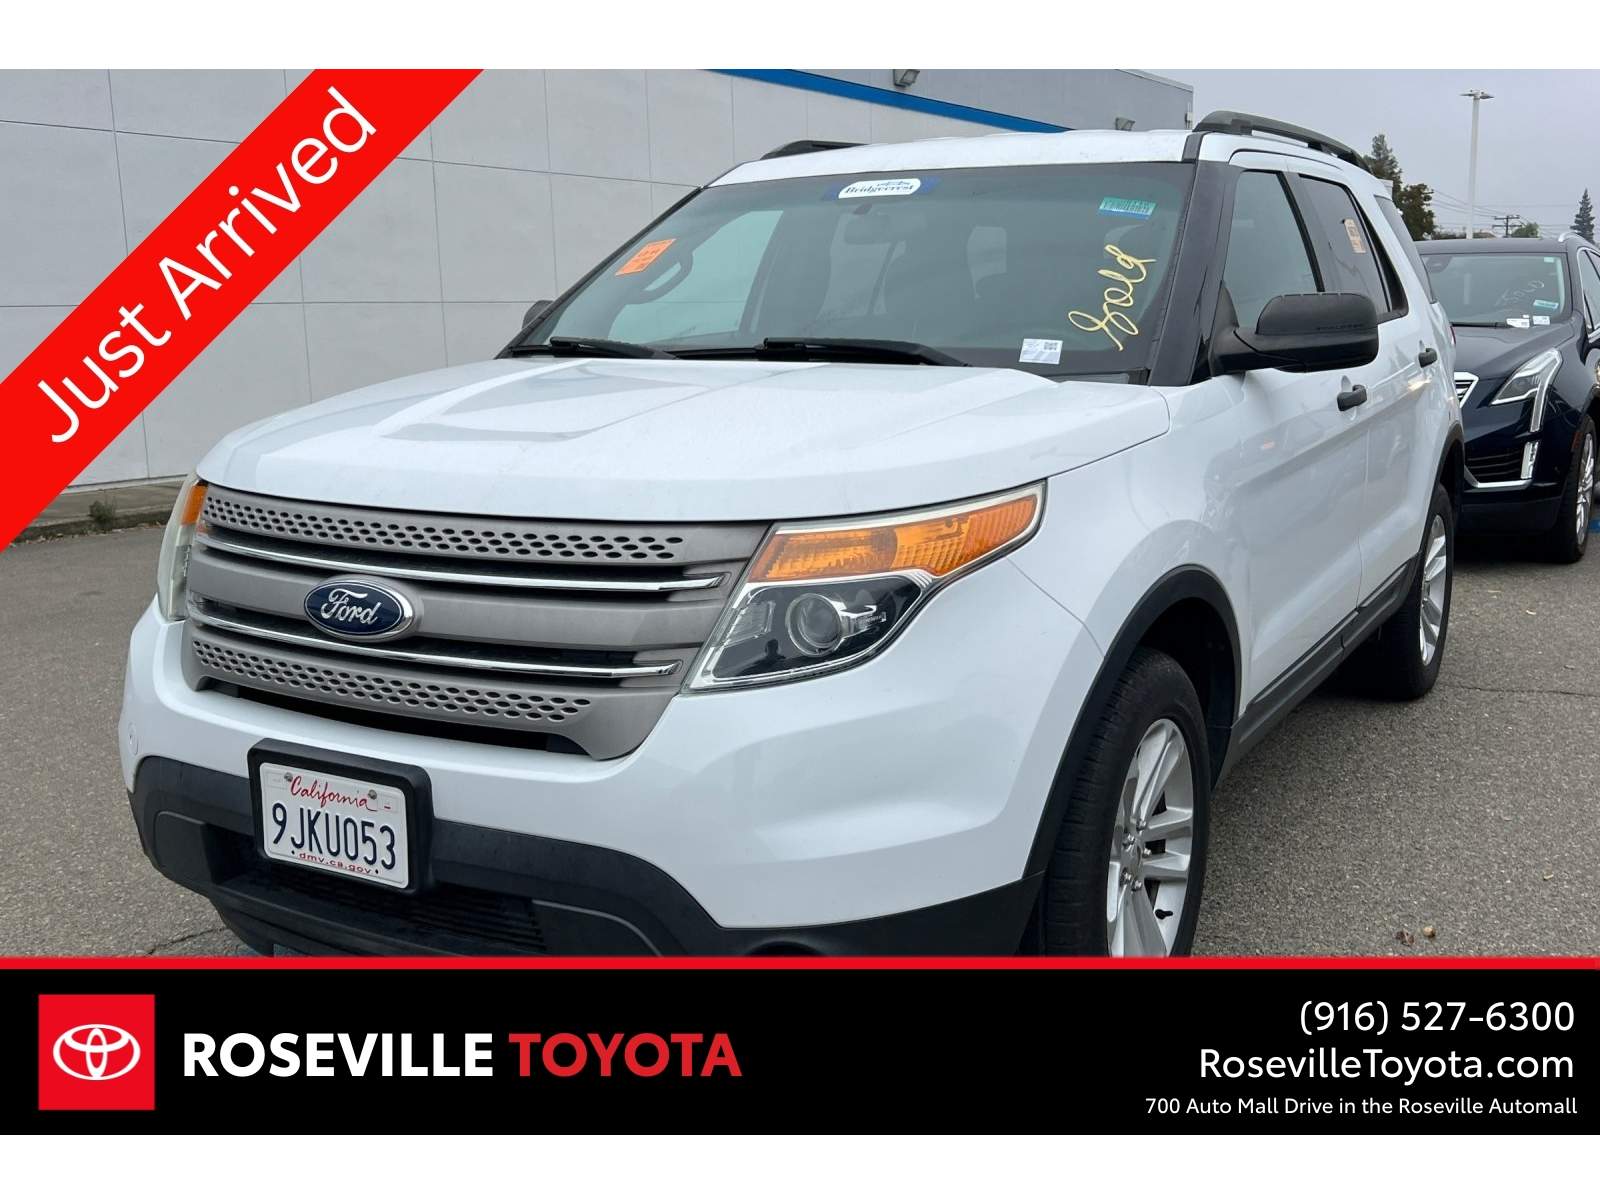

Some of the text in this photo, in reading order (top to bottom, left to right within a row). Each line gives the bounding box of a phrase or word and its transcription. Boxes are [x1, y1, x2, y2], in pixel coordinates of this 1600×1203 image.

[320, 587, 382, 626] Ford
[289, 774, 378, 813] California
[271, 801, 397, 871] 9JKU053
[298, 851, 373, 875] dmv.ca.gov
